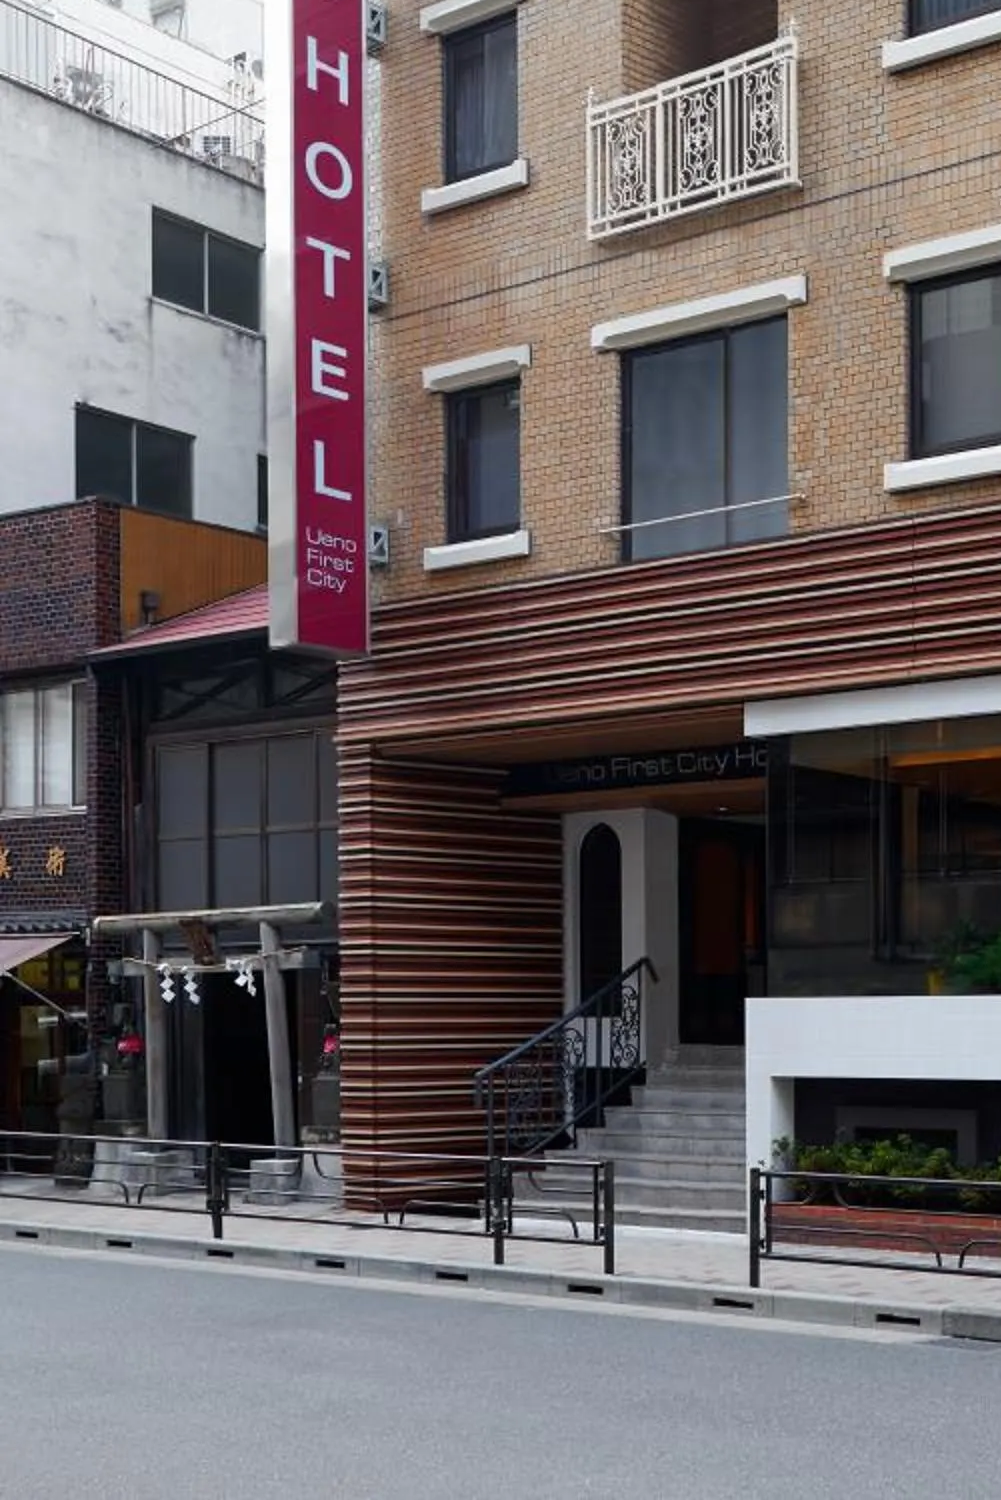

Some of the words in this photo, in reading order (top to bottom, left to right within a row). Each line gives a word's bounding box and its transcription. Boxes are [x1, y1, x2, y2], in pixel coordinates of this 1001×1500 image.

[305, 35, 353, 501] HOTEL
[305, 525, 357, 553] Ueno
[307, 547, 354, 573] First
[307, 568, 347, 593] City
[611, 756, 672, 778] First
[676, 752, 730, 775] City
